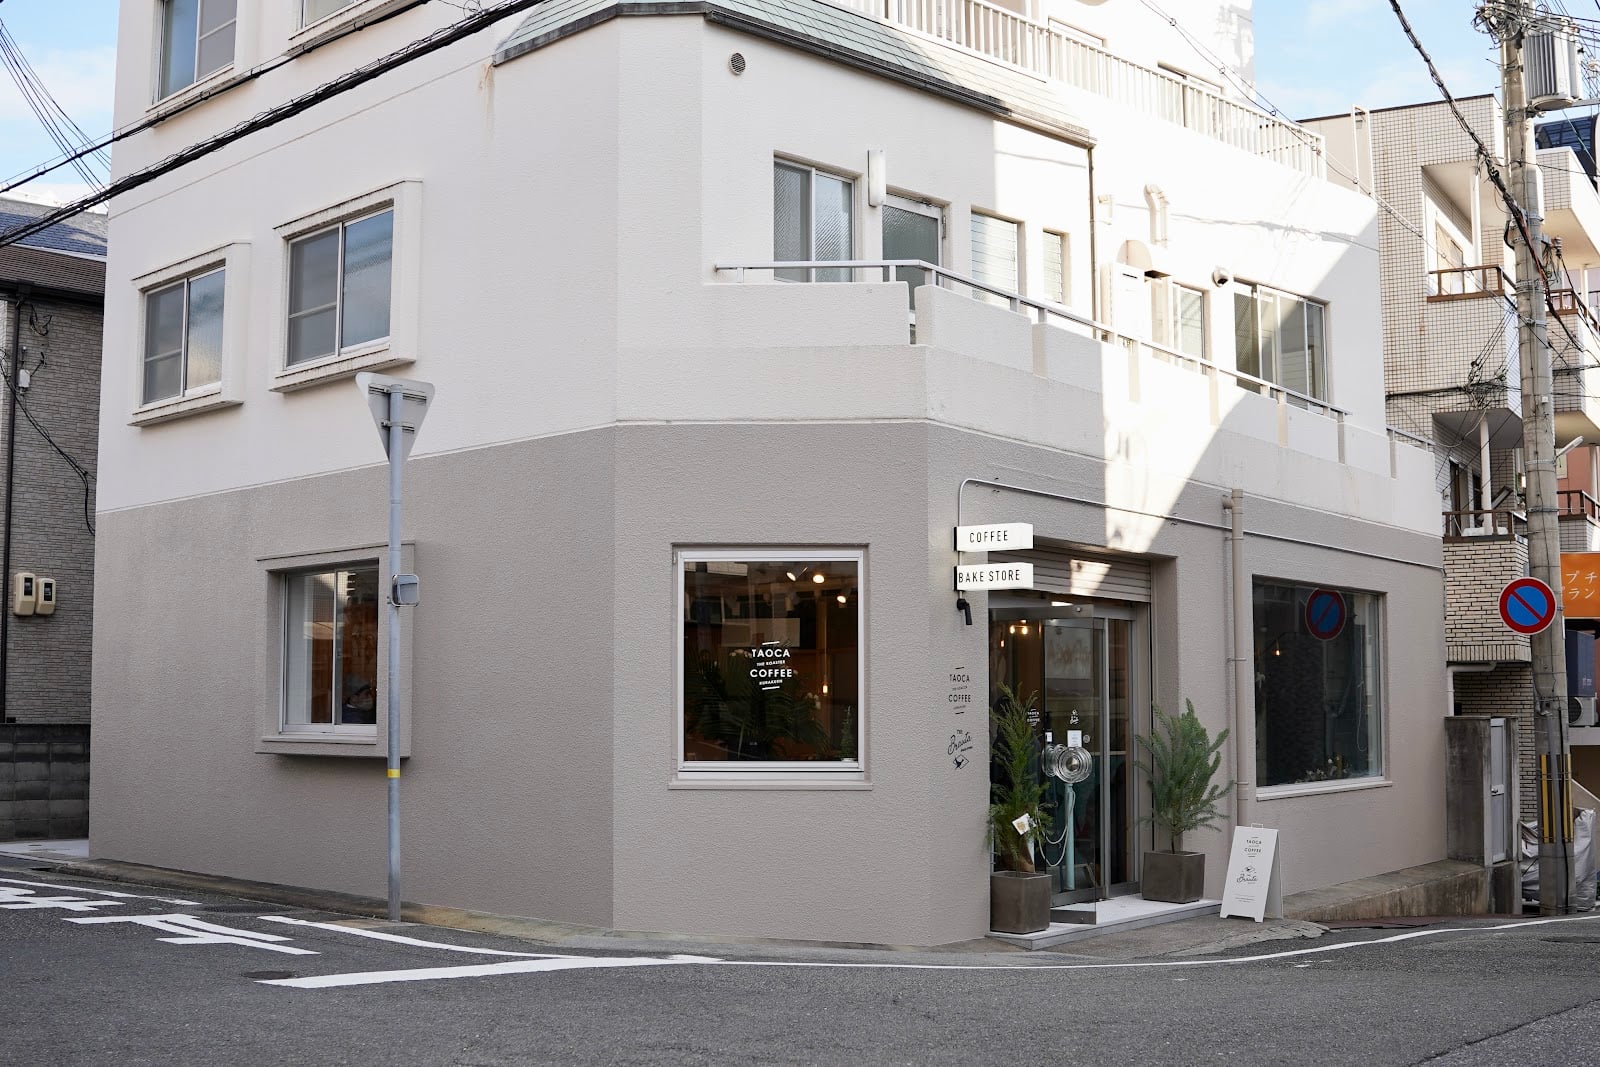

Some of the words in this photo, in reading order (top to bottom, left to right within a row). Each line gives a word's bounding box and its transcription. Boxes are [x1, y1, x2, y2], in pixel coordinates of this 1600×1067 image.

[969, 530, 1008, 543] COFFEE
[958, 571, 985, 583] BAKE
[988, 569, 1020, 582] STORE
[751, 648, 791, 658] TAOCA
[749, 668, 793, 678] COFFEE
[949, 674, 970, 683] TAOCA
[948, 694, 971, 703] COFFEE
